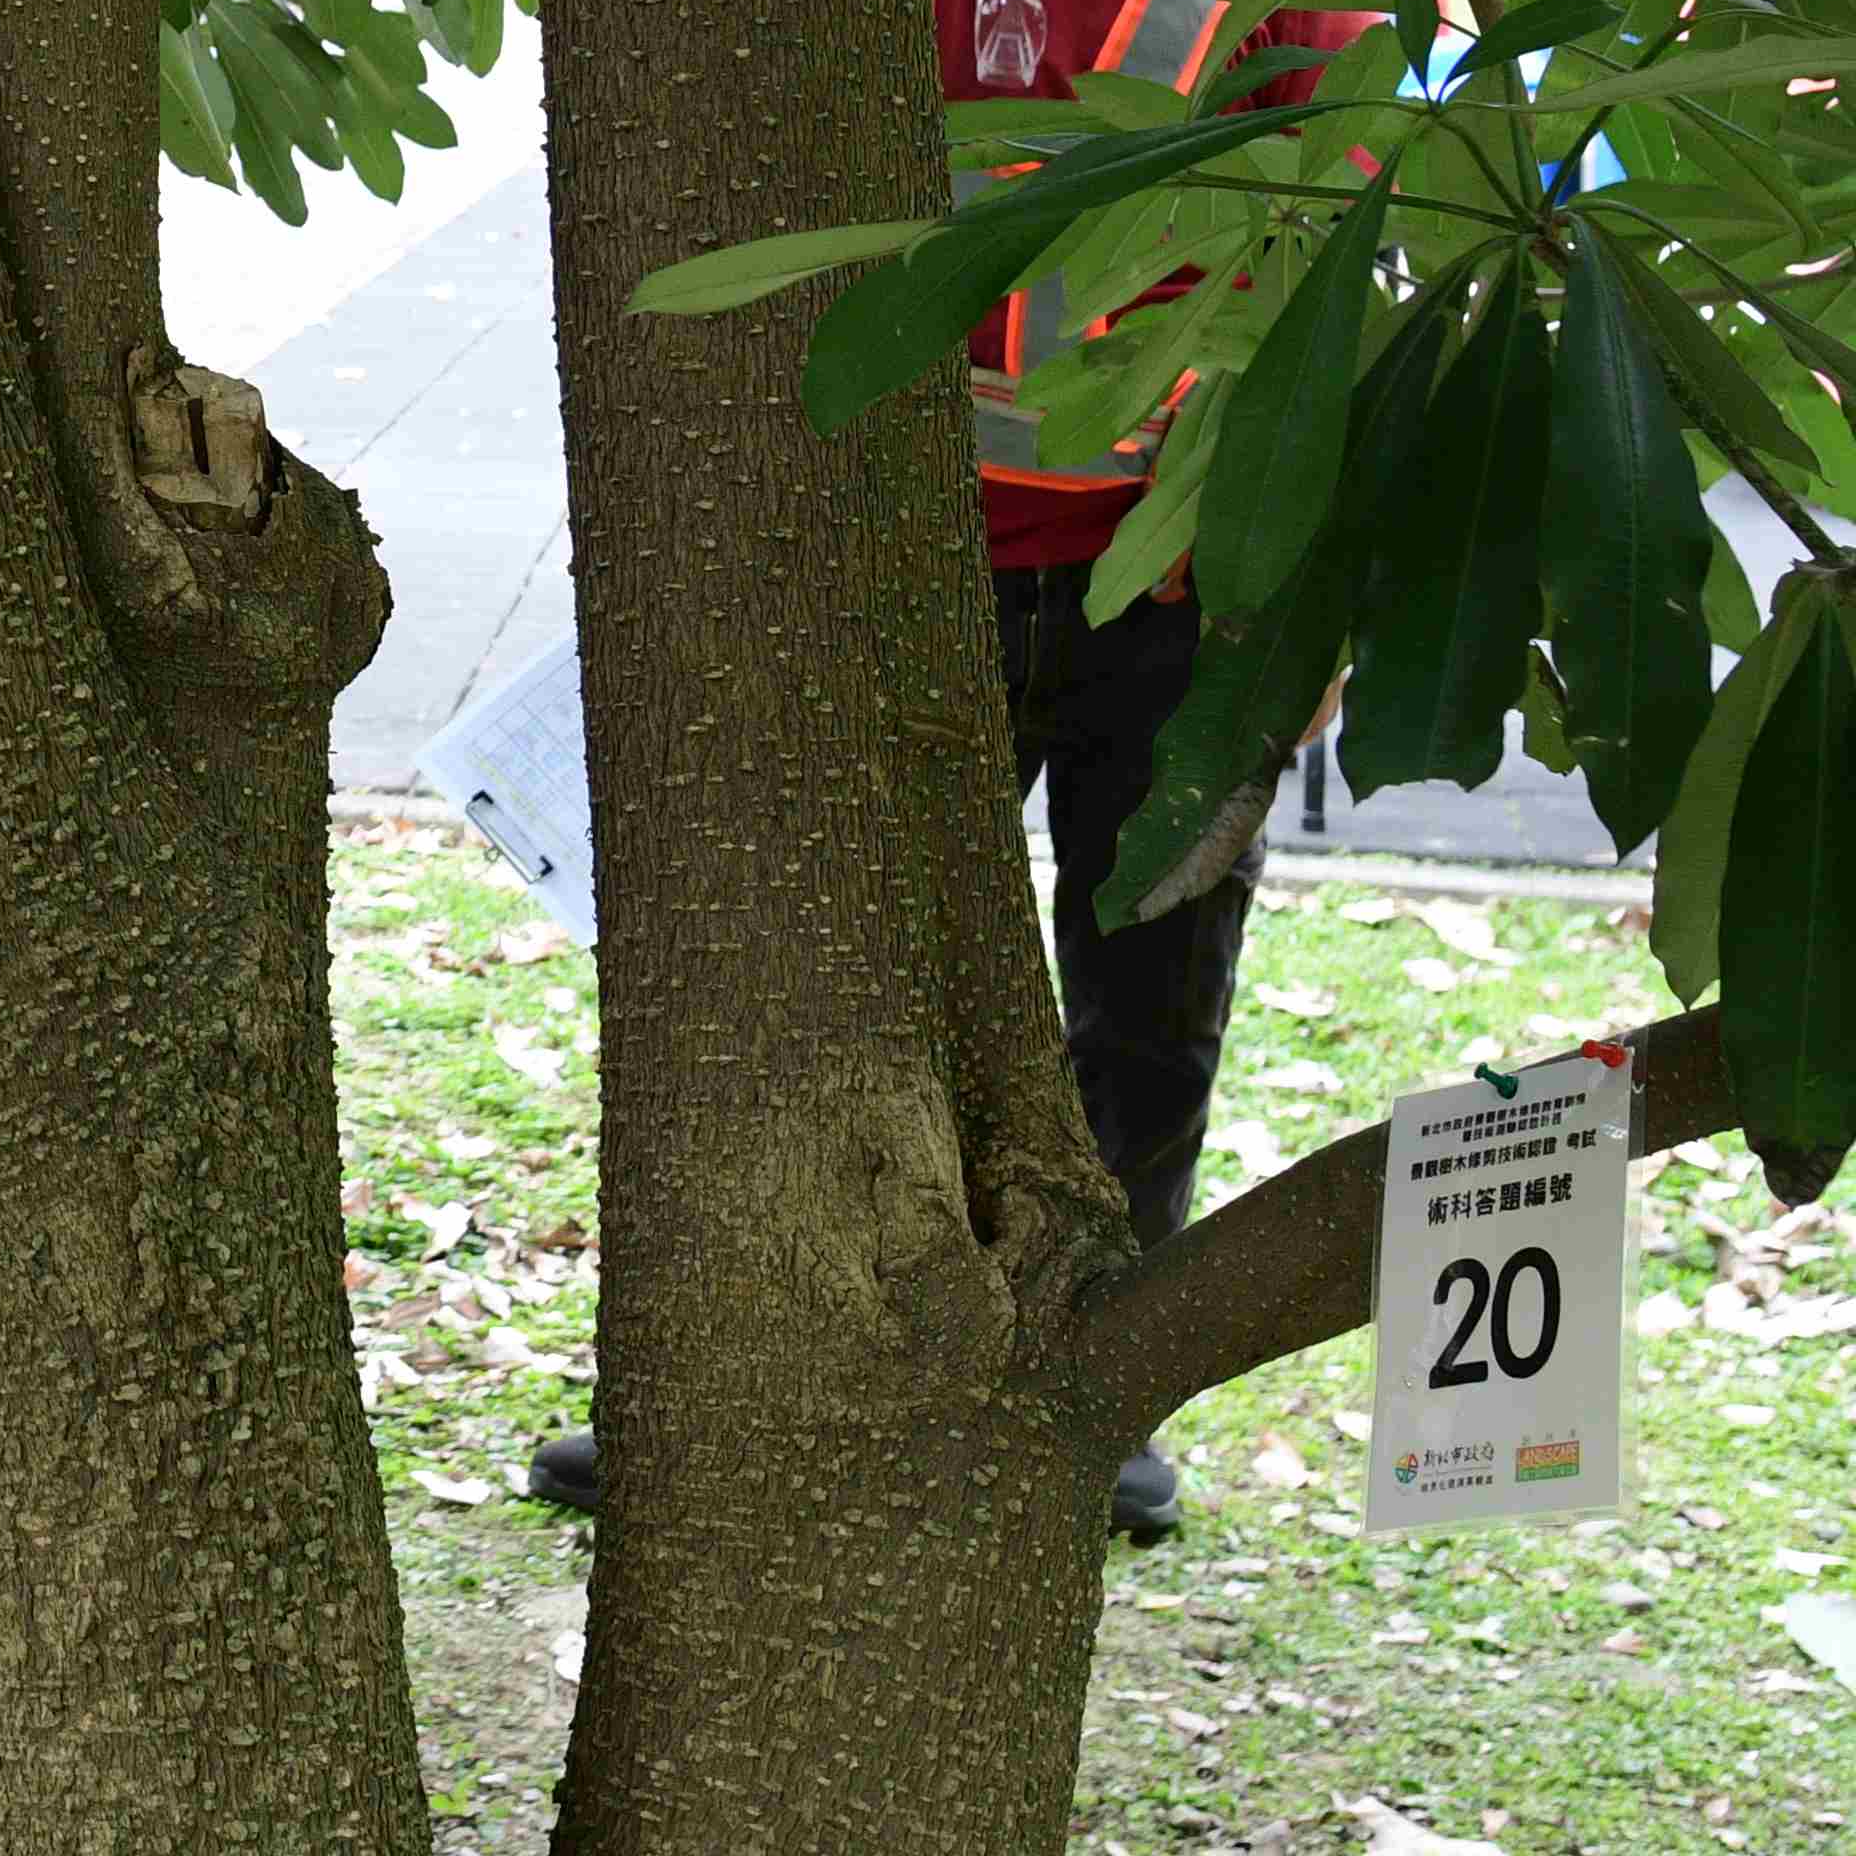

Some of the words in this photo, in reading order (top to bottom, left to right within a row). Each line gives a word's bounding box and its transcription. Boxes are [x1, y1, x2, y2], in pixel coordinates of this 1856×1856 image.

[1567, 1128, 1597, 1150] 考試
[1428, 1173, 1572, 1227] 術科答題編號
[1428, 1246, 1561, 1390] 20
